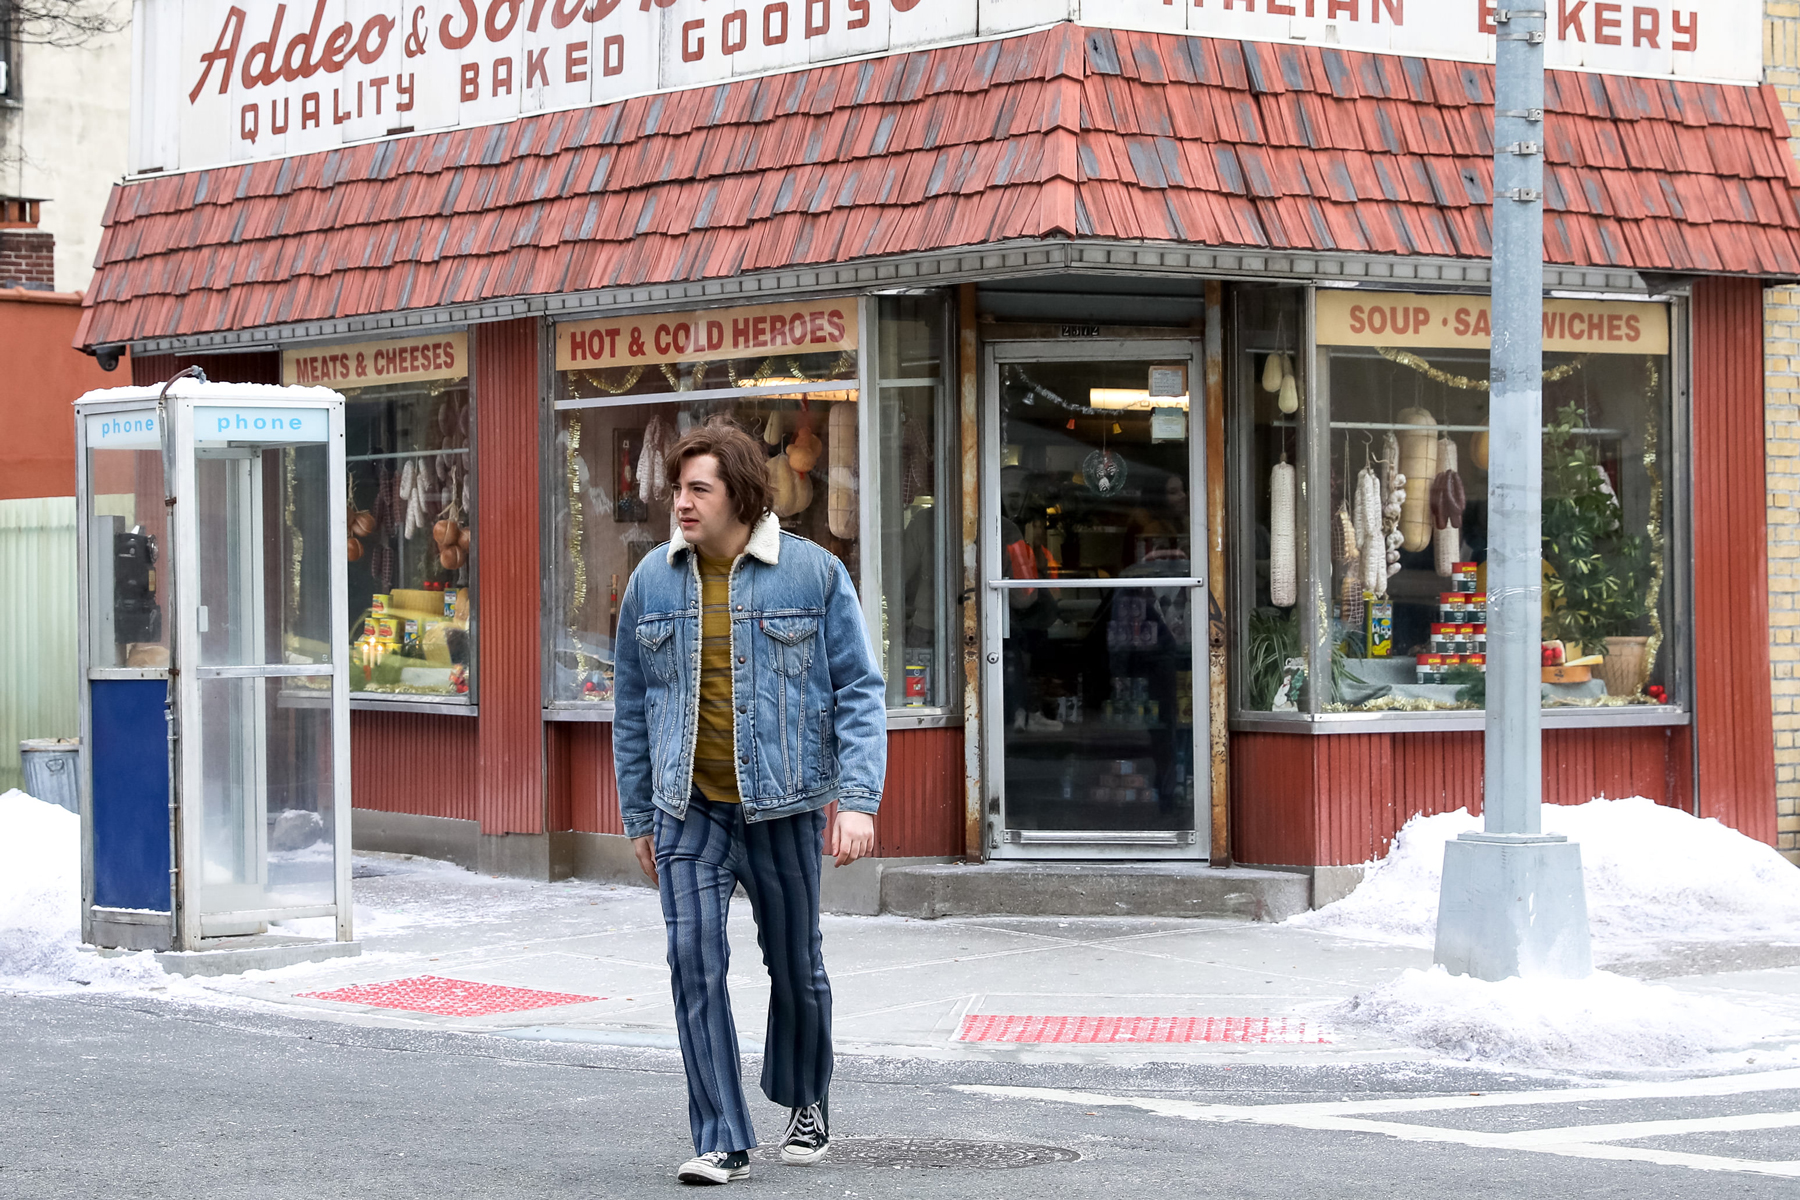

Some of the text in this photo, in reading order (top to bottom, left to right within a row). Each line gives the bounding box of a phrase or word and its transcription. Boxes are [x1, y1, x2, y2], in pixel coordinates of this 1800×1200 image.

[1478, 0, 1698, 51] BKERY
[189, 0, 396, 105] Addeo
[404, 6, 428, 58] &
[240, 0, 870, 145] QUALITY BAKED GOODS
[570, 309, 846, 361] HOT & COLD HEROES
[1349, 302, 1641, 342] SOUP SAWICHES
[295, 341, 455, 384] MEATS & CHEESES
[102, 418, 155, 438] phone
[216, 414, 303, 432] phone
